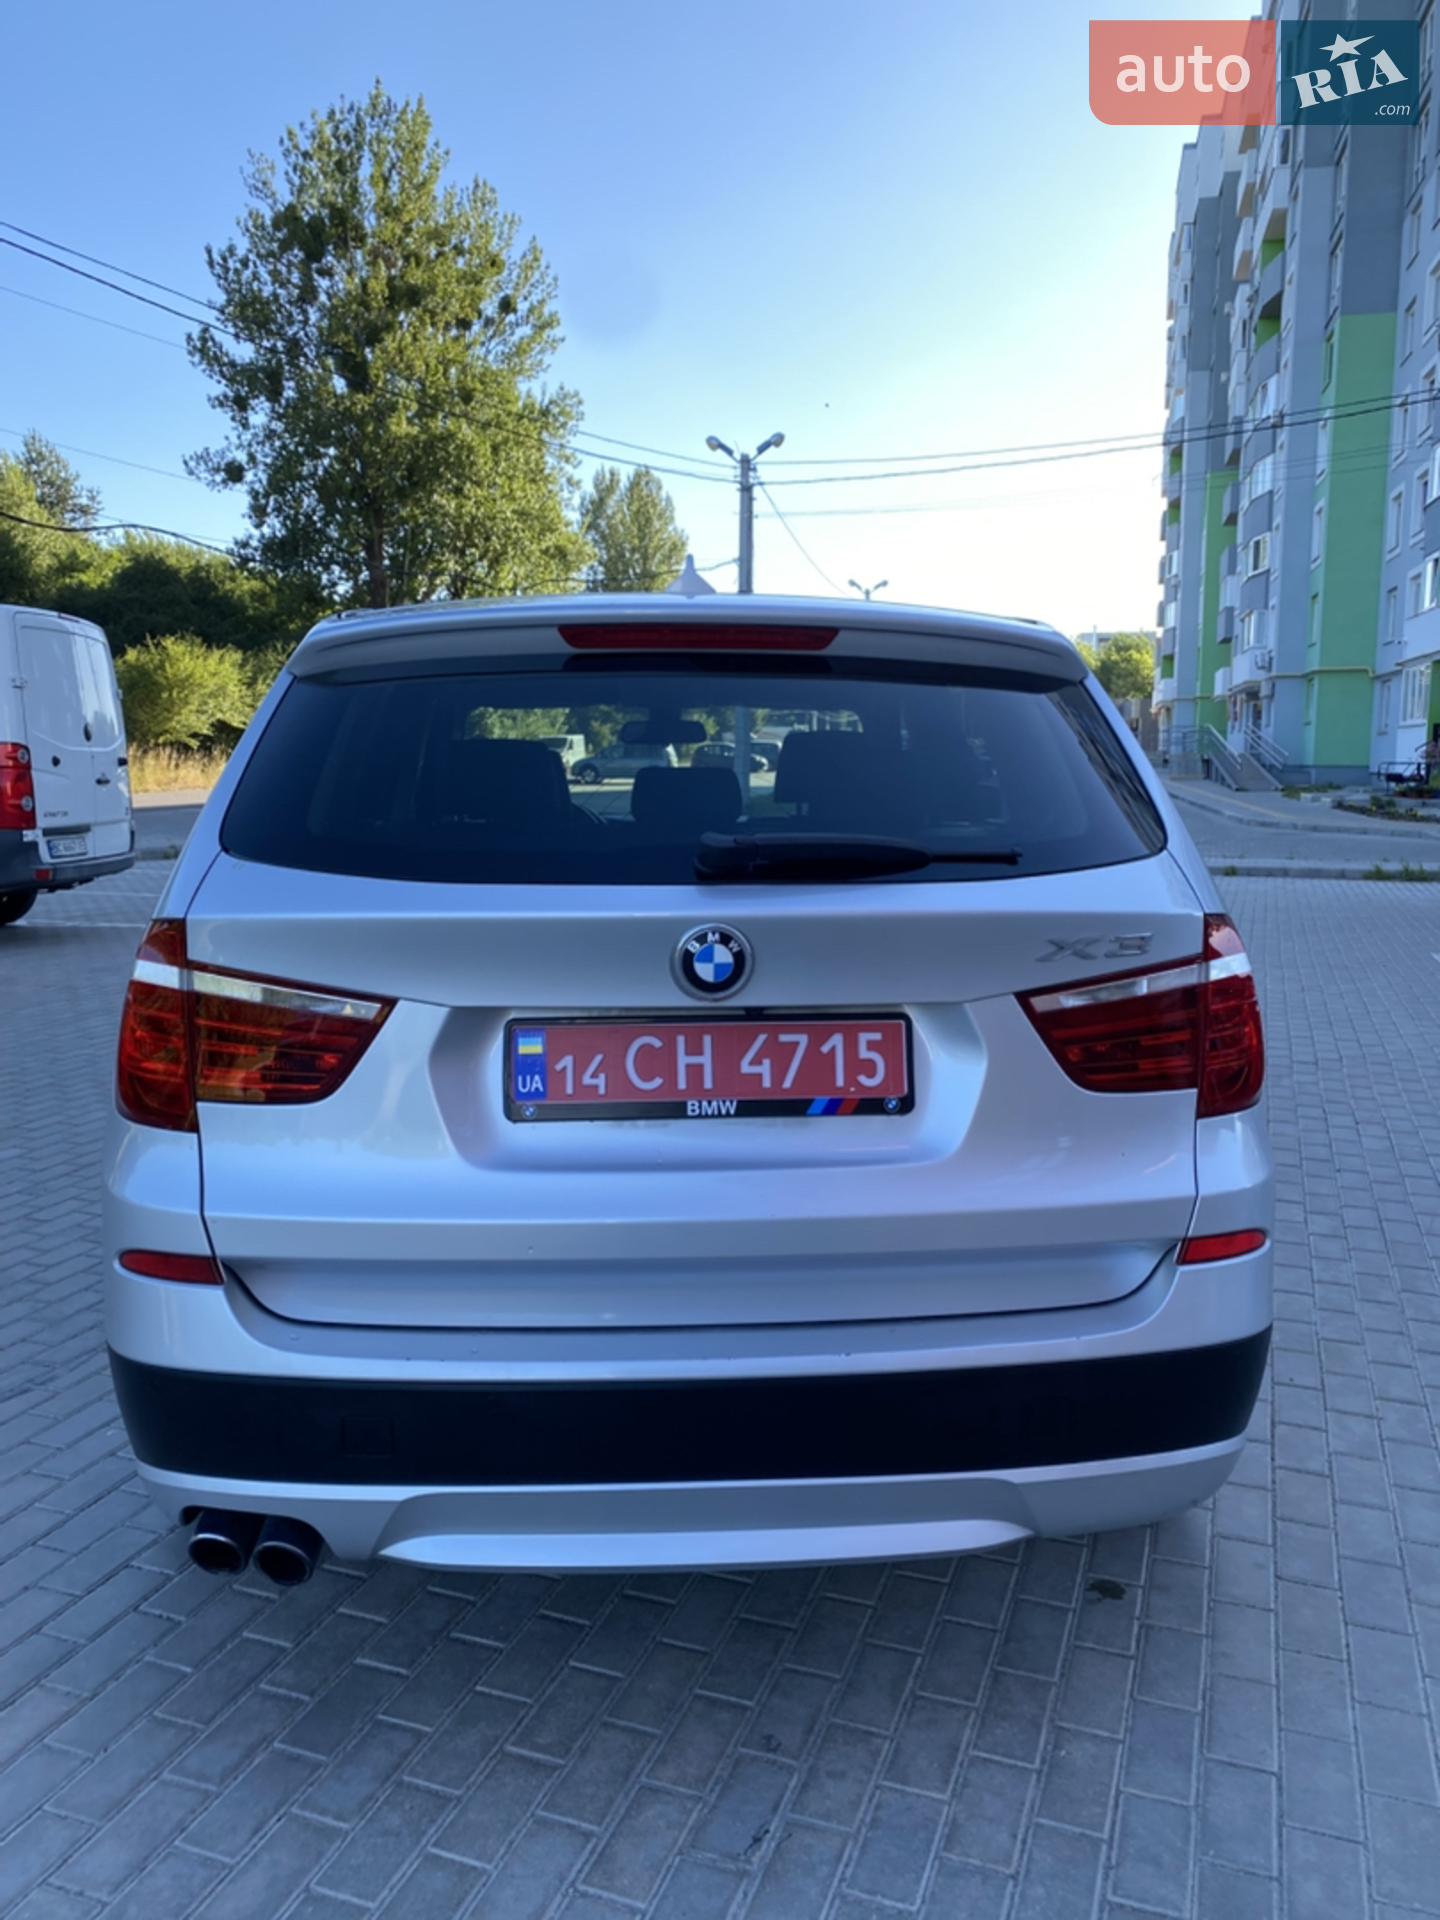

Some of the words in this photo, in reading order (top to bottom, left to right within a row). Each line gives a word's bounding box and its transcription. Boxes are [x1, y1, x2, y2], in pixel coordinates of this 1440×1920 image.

[687, 931, 742, 954] BMW
[1034, 931, 1155, 962] X3
[554, 1053, 606, 1095] 14
[625, 1034, 714, 1091] CH
[740, 1032, 886, 1088] 4715
[518, 1075, 544, 1093] UA
[686, 1099, 738, 1116] BMW
